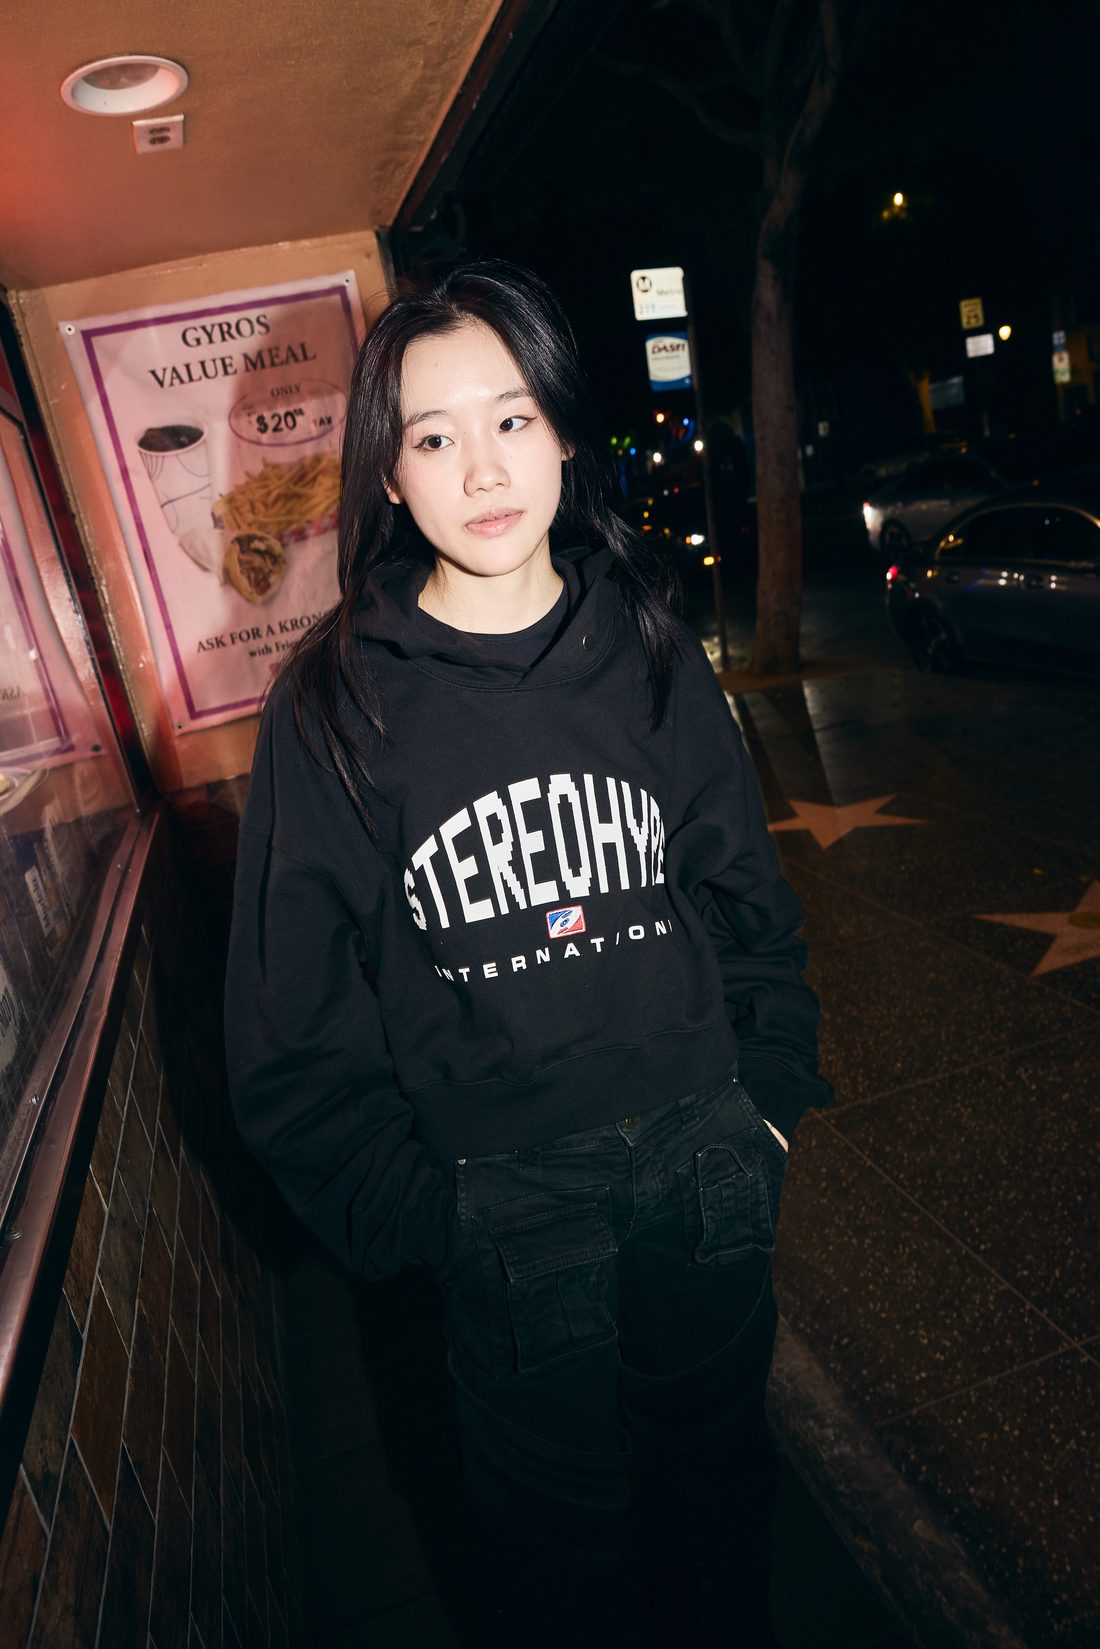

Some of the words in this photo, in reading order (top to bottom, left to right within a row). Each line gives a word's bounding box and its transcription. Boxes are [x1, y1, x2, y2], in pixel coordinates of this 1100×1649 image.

[181, 314, 271, 348] GYROS
[149, 357, 238, 390] VALUE
[243, 342, 317, 373] MEAL
[270, 384, 302, 398] ONLY
[197, 633, 227, 653] ASK
[229, 626, 263, 645] FOR
[265, 624, 276, 637] A
[248, 642, 273, 659] with
[434, 919, 673, 983] INTERNATION
